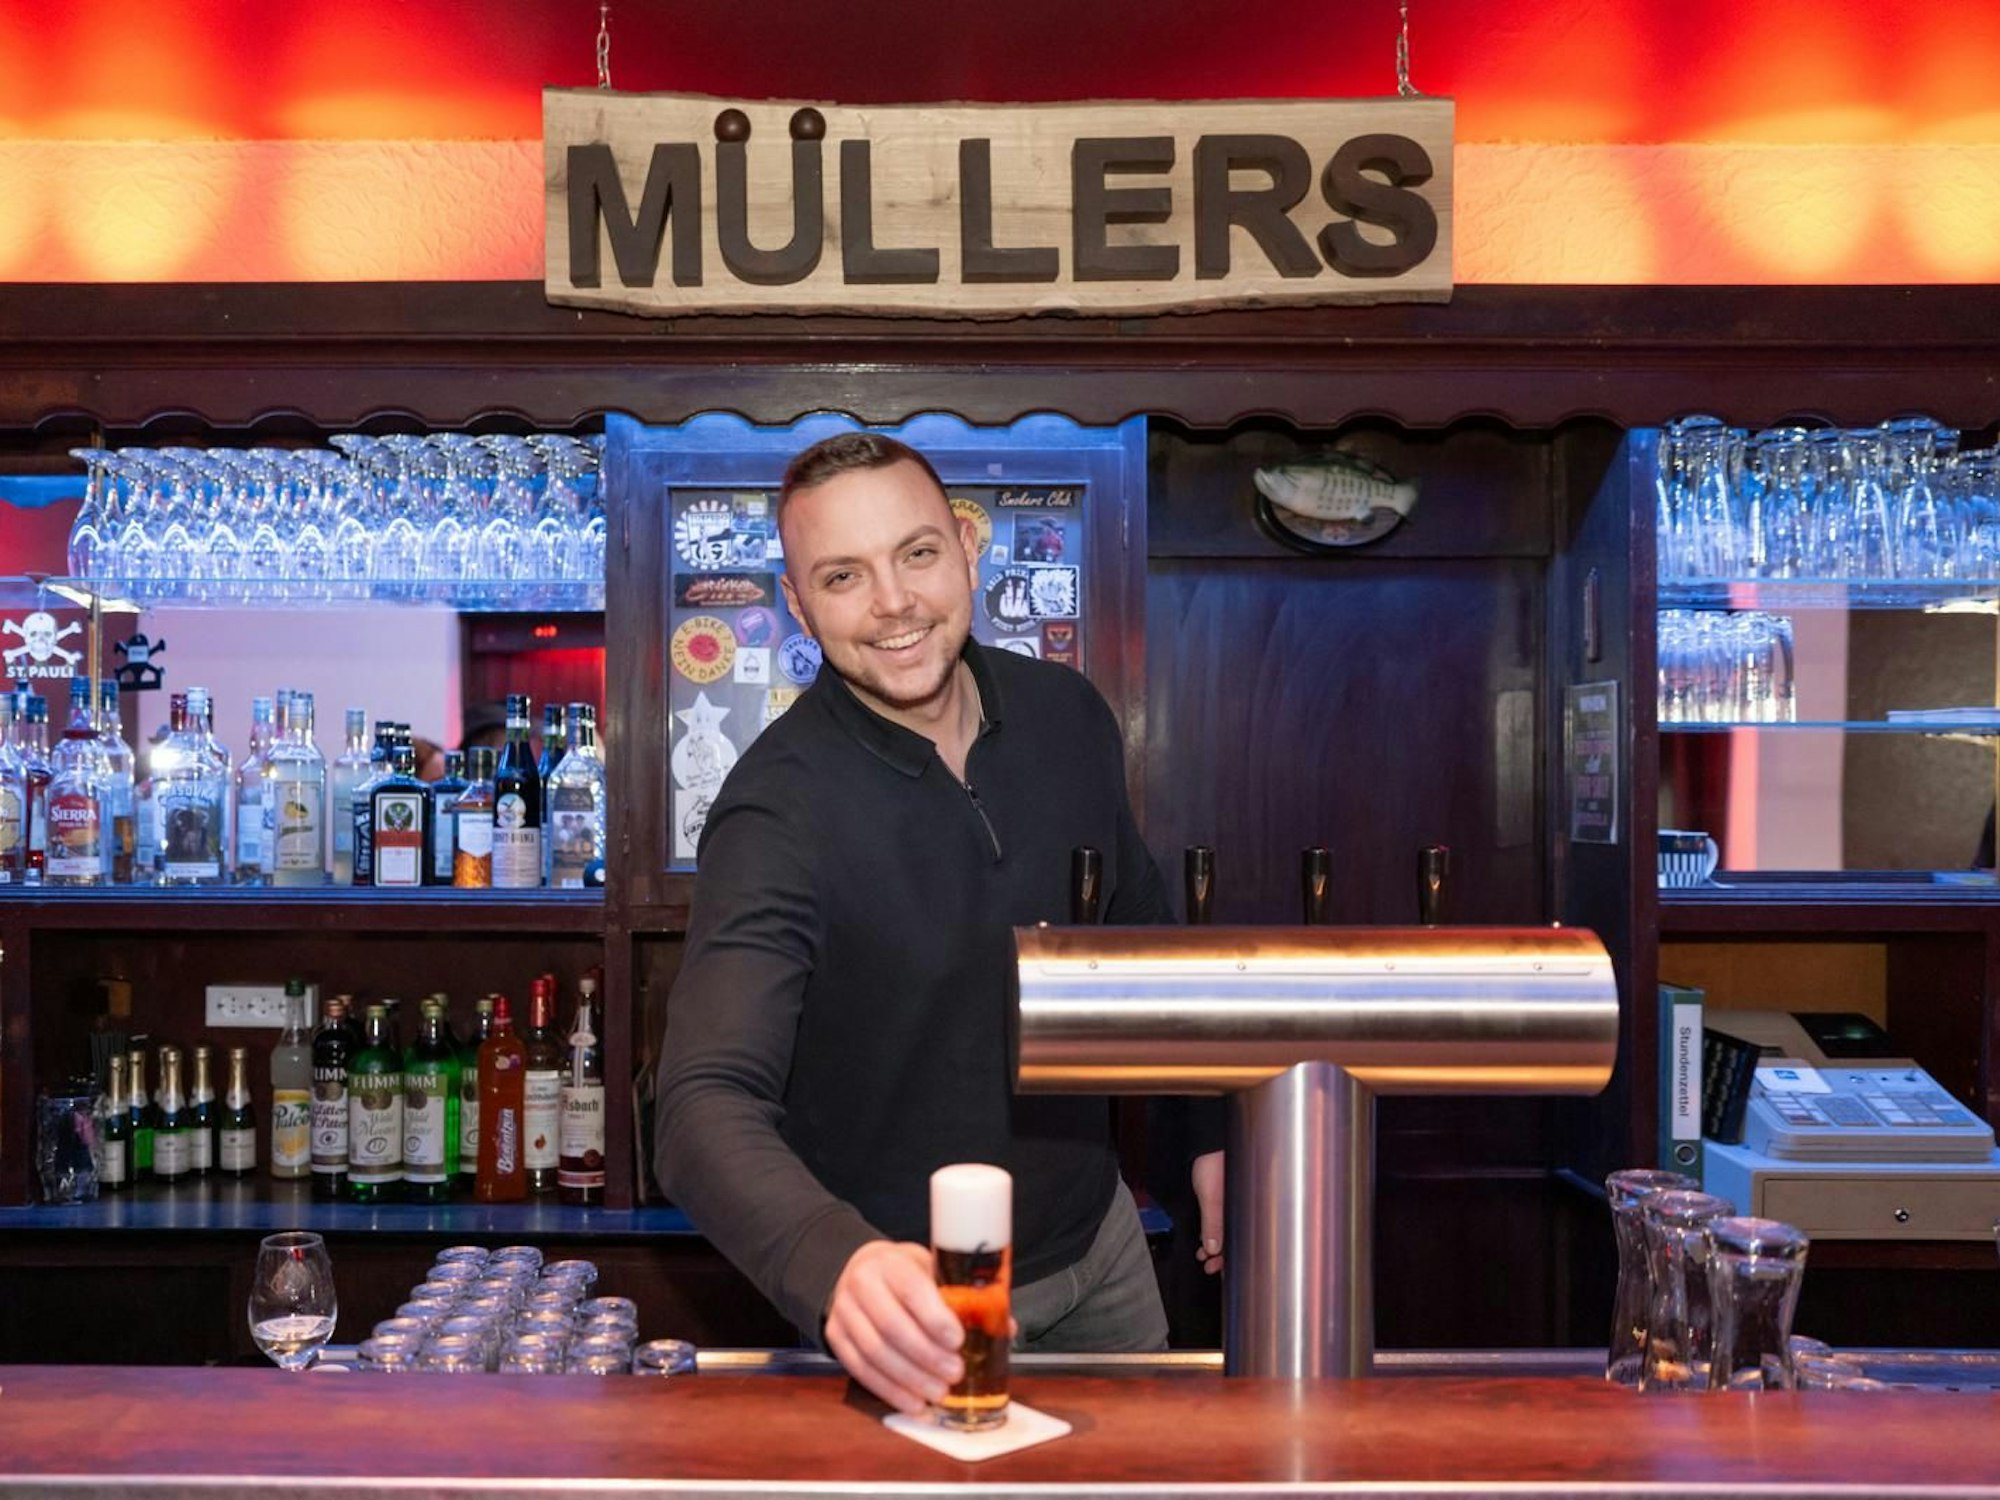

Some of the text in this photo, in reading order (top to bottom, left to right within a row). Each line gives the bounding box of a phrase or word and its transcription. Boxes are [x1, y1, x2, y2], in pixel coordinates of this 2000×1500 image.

[566, 107, 1439, 288] MÜLLERS
[28, 666, 75, 678] PAULI
[1679, 1026, 1692, 1117] Stundenzettel
